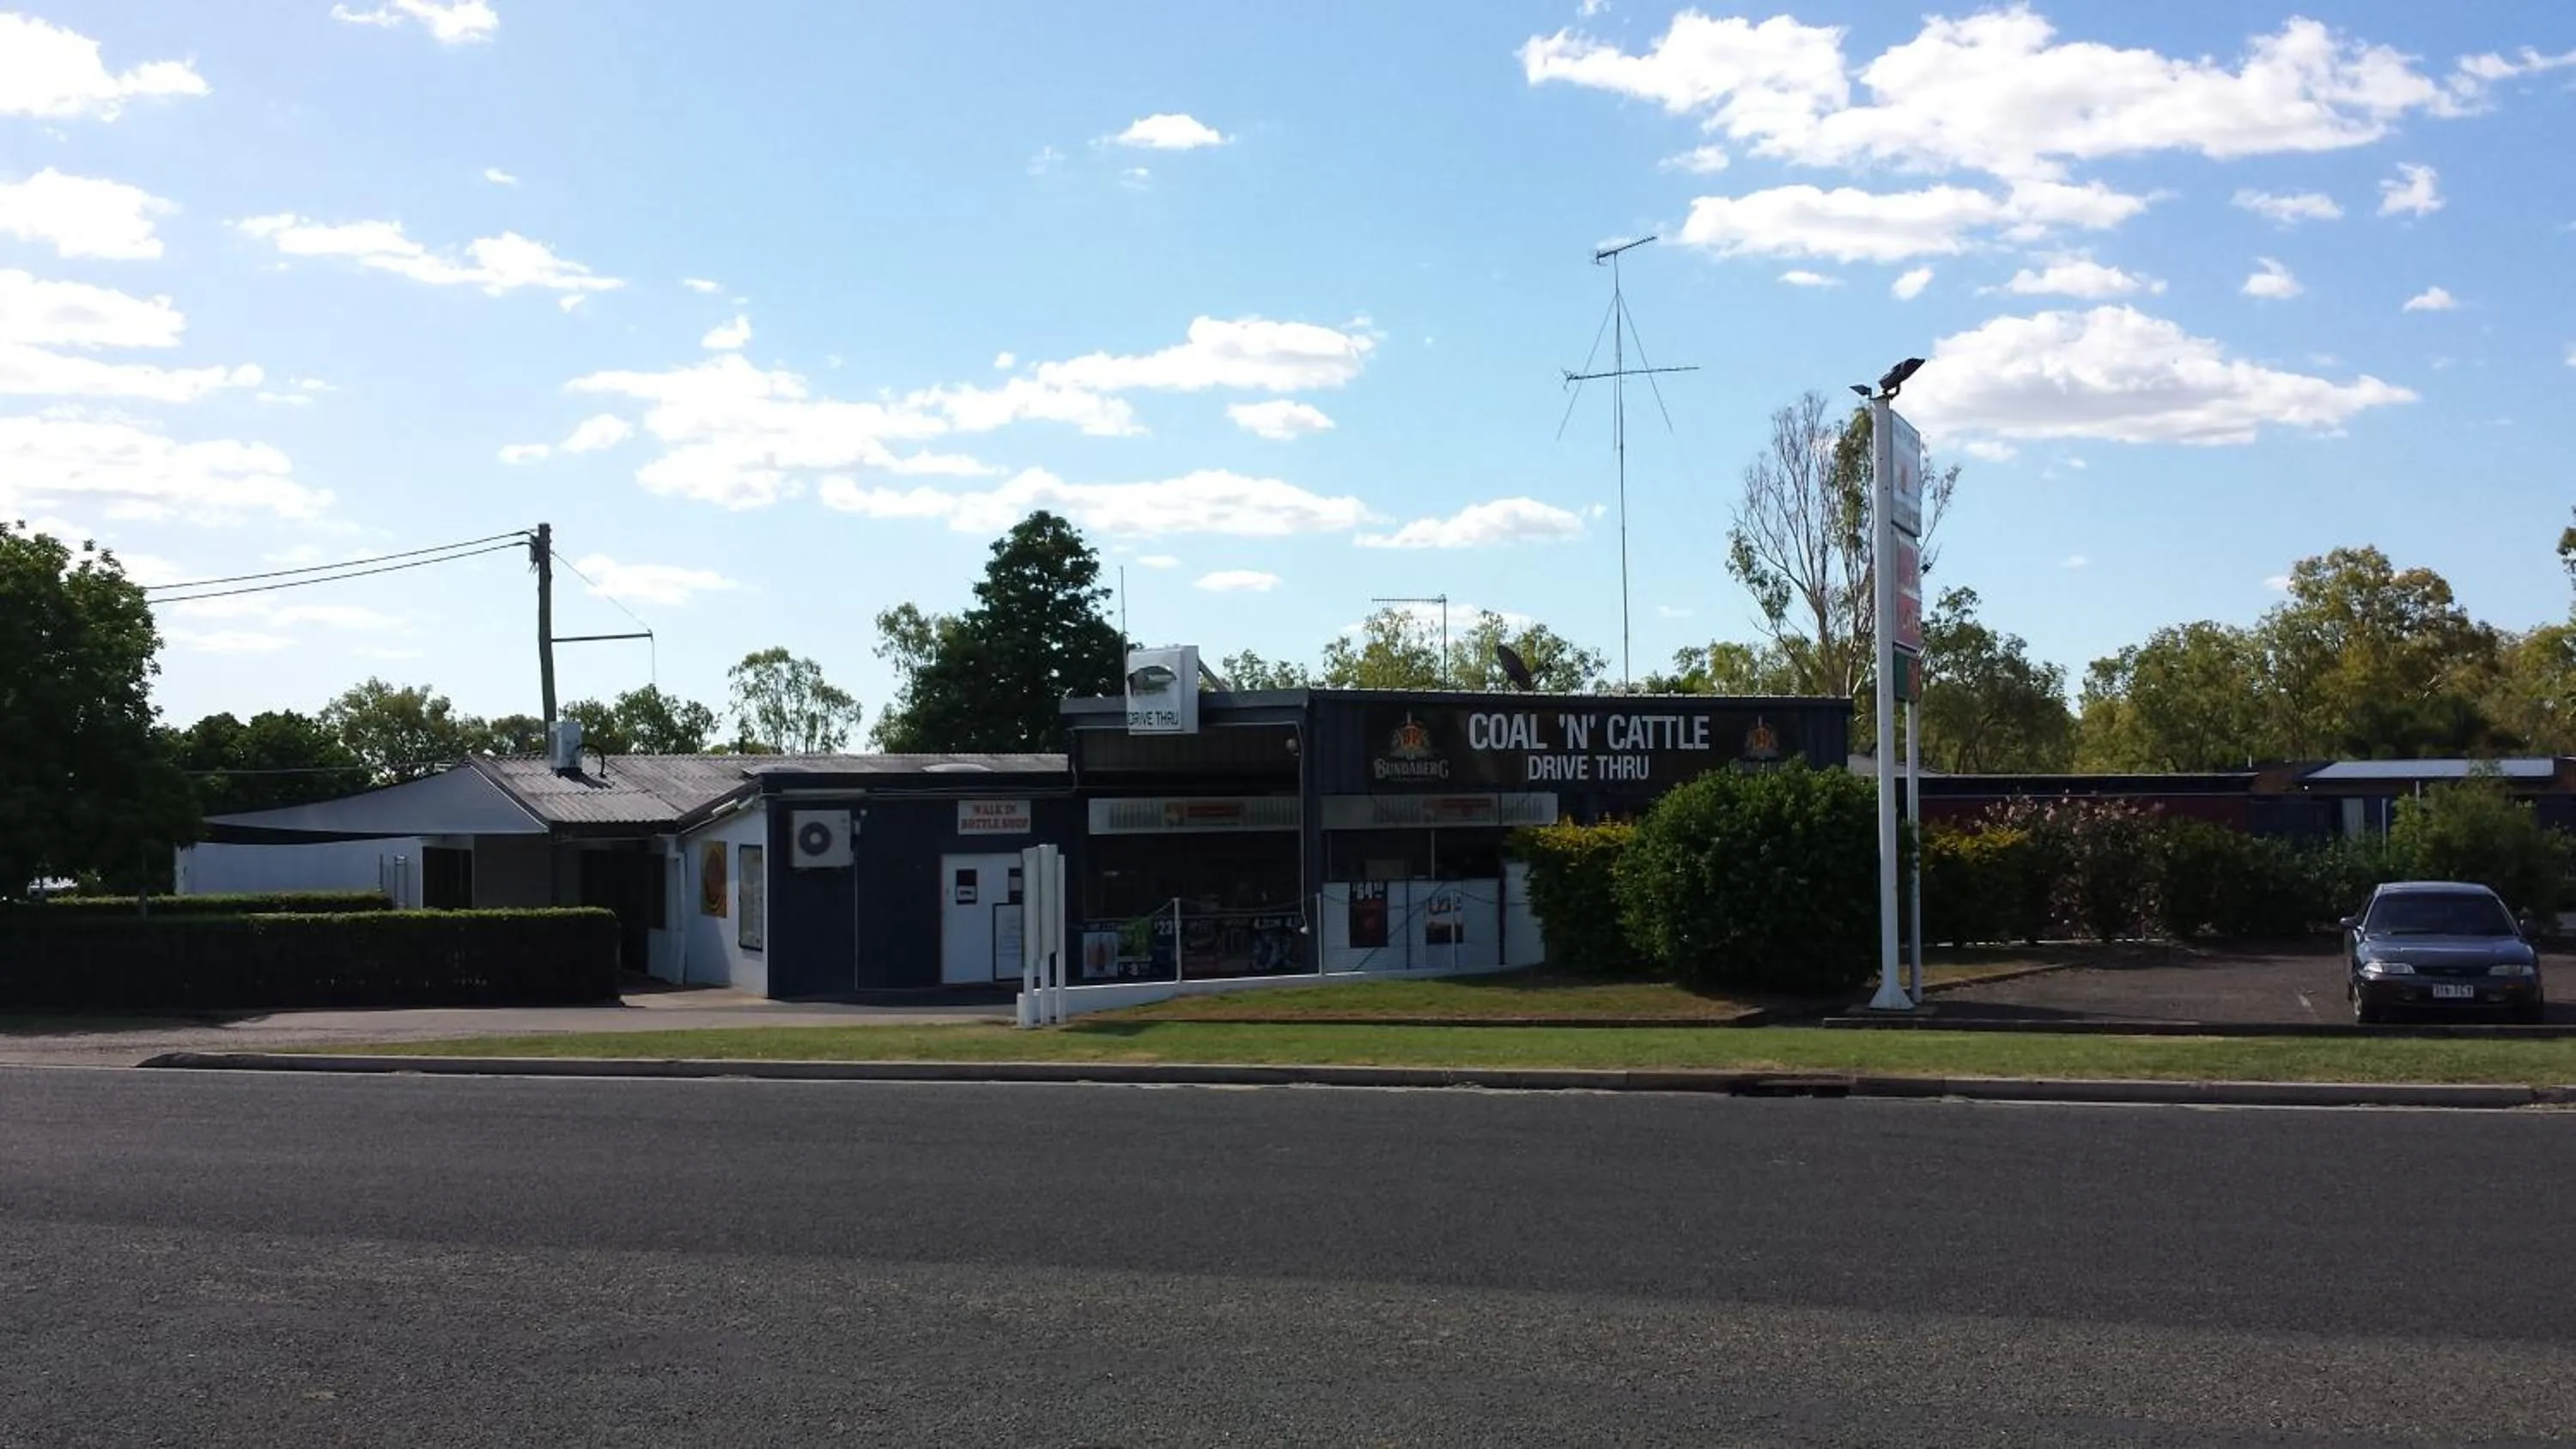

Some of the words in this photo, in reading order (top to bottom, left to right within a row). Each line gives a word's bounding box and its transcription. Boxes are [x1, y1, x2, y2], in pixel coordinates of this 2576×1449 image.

[1128, 712, 1153, 725] DRIVE
[1156, 711, 1179, 725] THRU
[1468, 713, 1547, 750] COAL
[1558, 713, 1597, 750] 'N'
[1607, 714, 1710, 750] CATTLE
[1528, 755, 1589, 780] DRIVE
[1595, 755, 1649, 780] THRU
[973, 804, 1002, 815] WALK
[961, 818, 999, 829] BOTTLE
